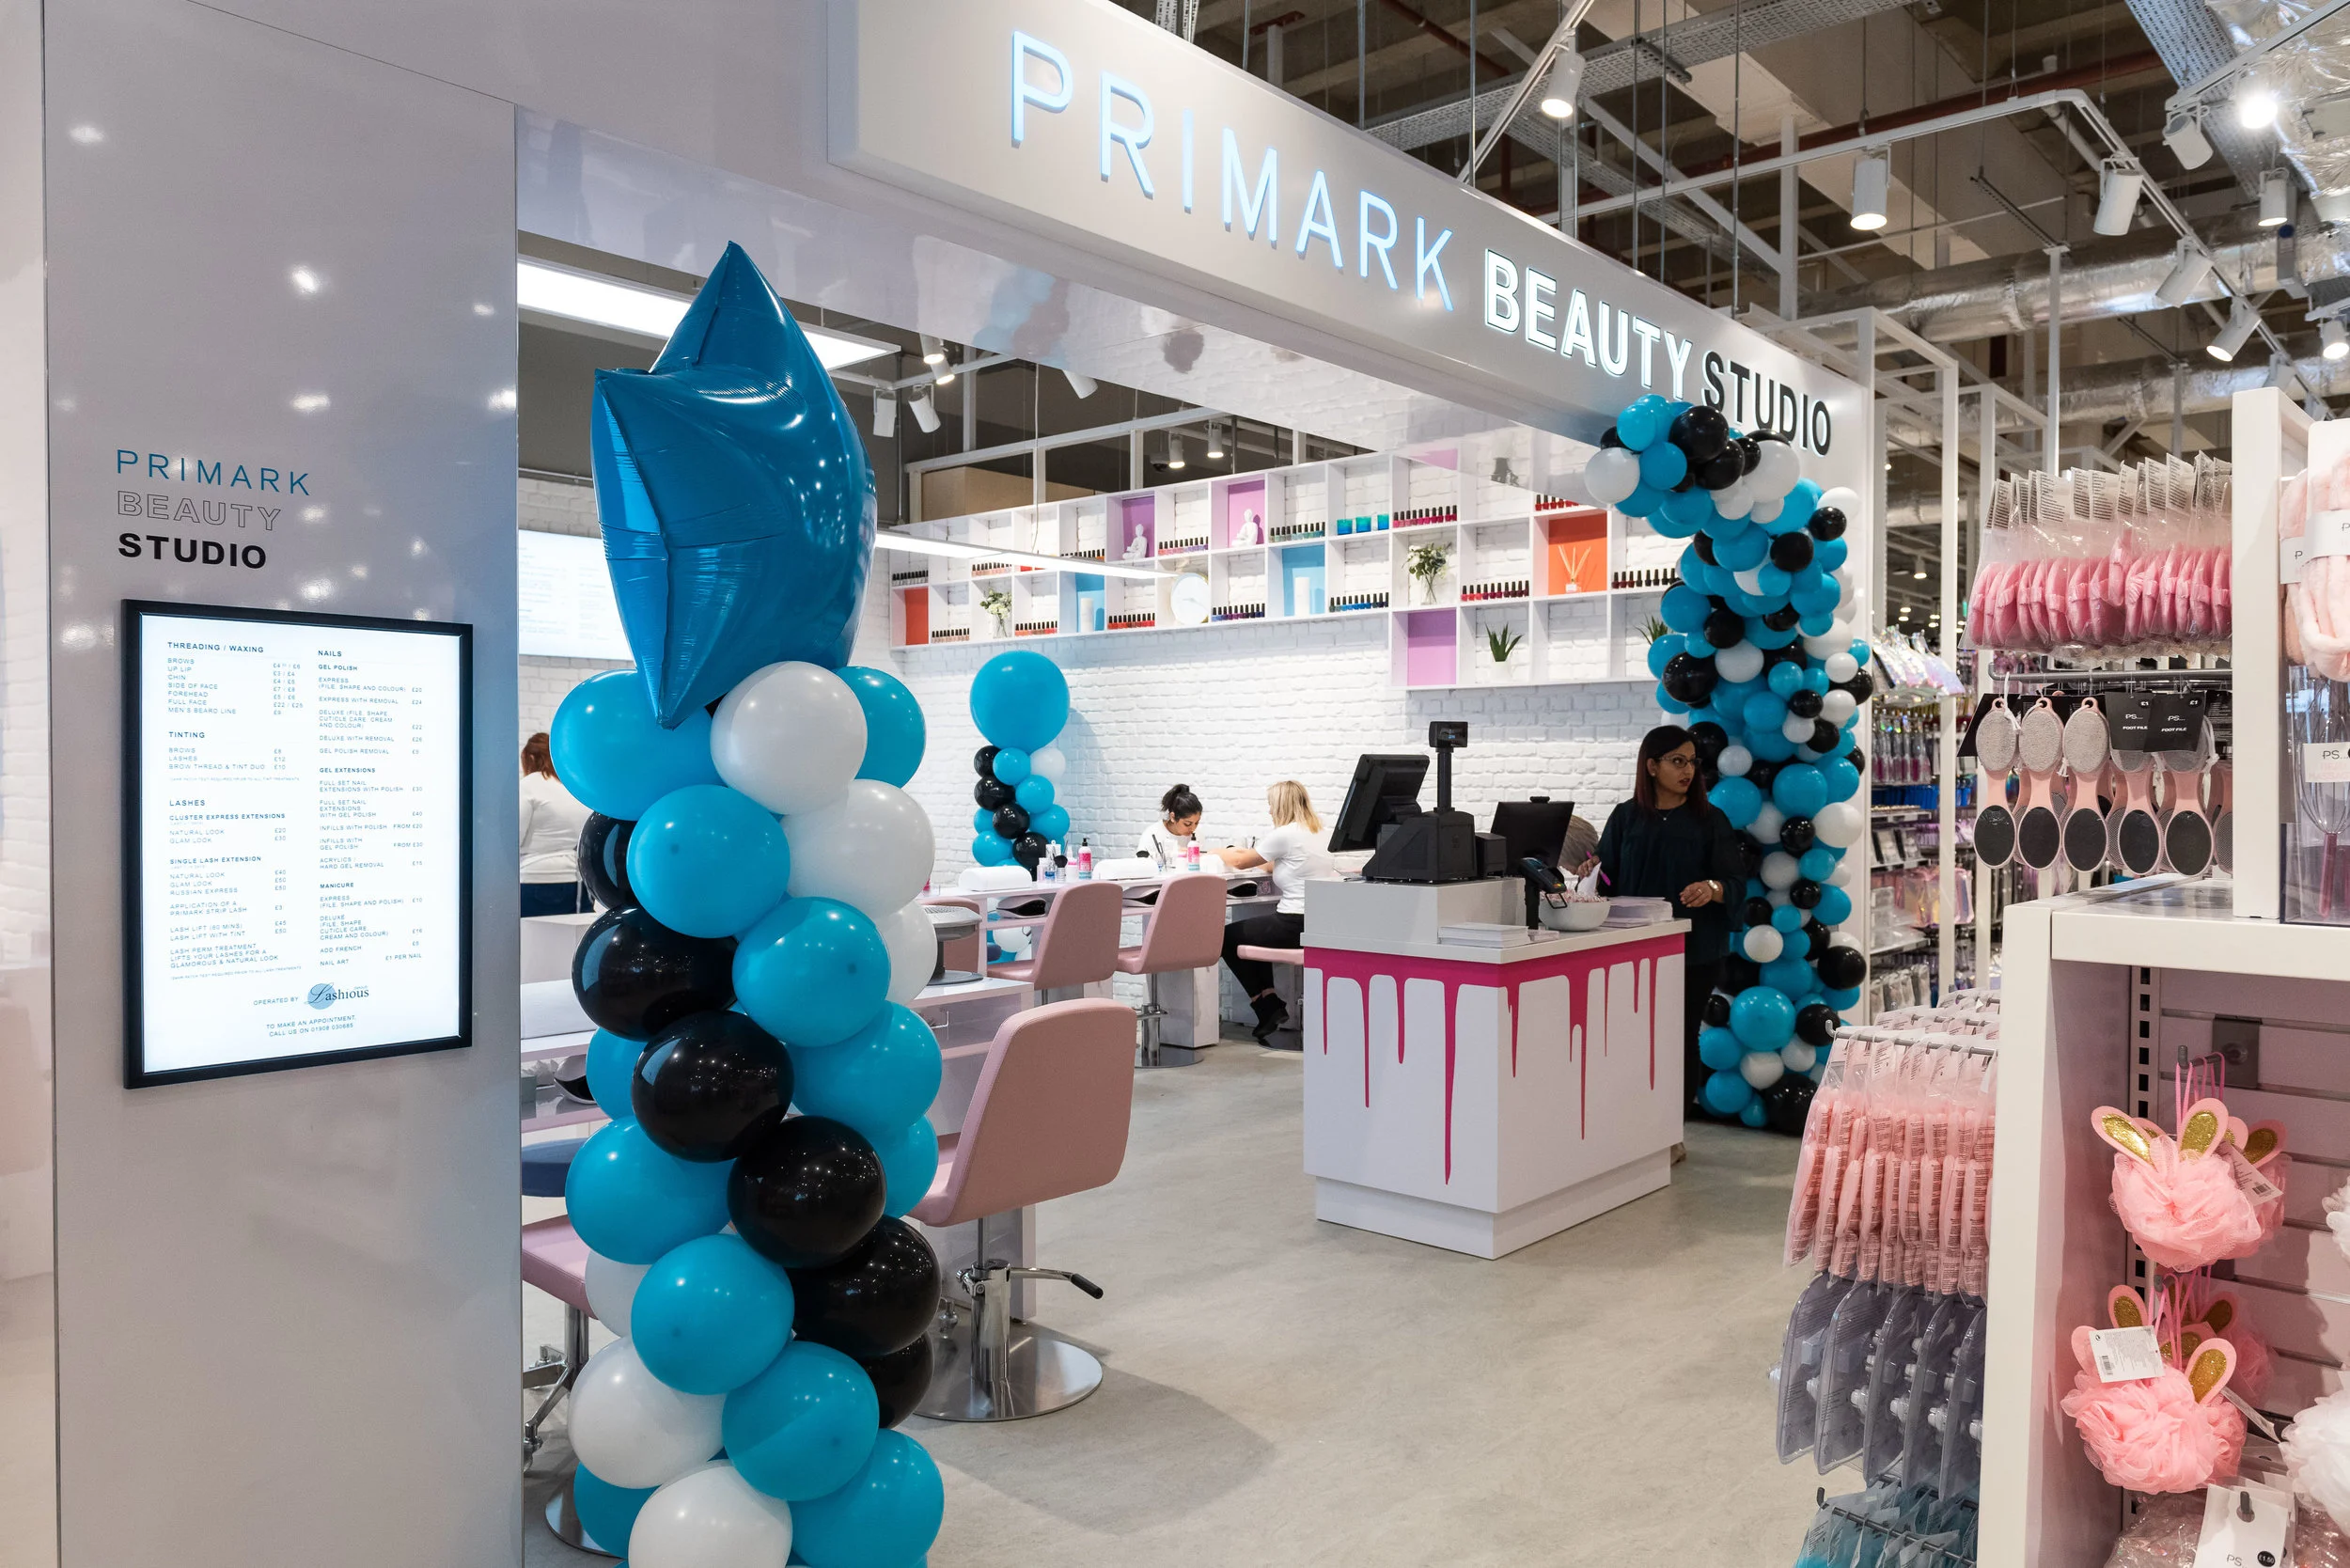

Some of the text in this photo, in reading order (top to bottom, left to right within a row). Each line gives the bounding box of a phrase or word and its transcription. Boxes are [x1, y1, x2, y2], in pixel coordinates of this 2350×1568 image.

[1011, 29, 1833, 458] PRIMARK BEAUTY STUDIO
[117, 448, 310, 496] PRIMARK
[118, 490, 281, 531] BEAUTY
[118, 532, 267, 570] STUDIO
[167, 641, 264, 653] THREADING WAXING
[215, 943, 257, 951] TREATMENT
[215, 950, 243, 959] LASHES
[170, 959, 216, 968] GLAMOROUS
[226, 956, 258, 964] NATURAL
[253, 997, 289, 1006] OPERATED
[304, 981, 369, 1005] Lashious
